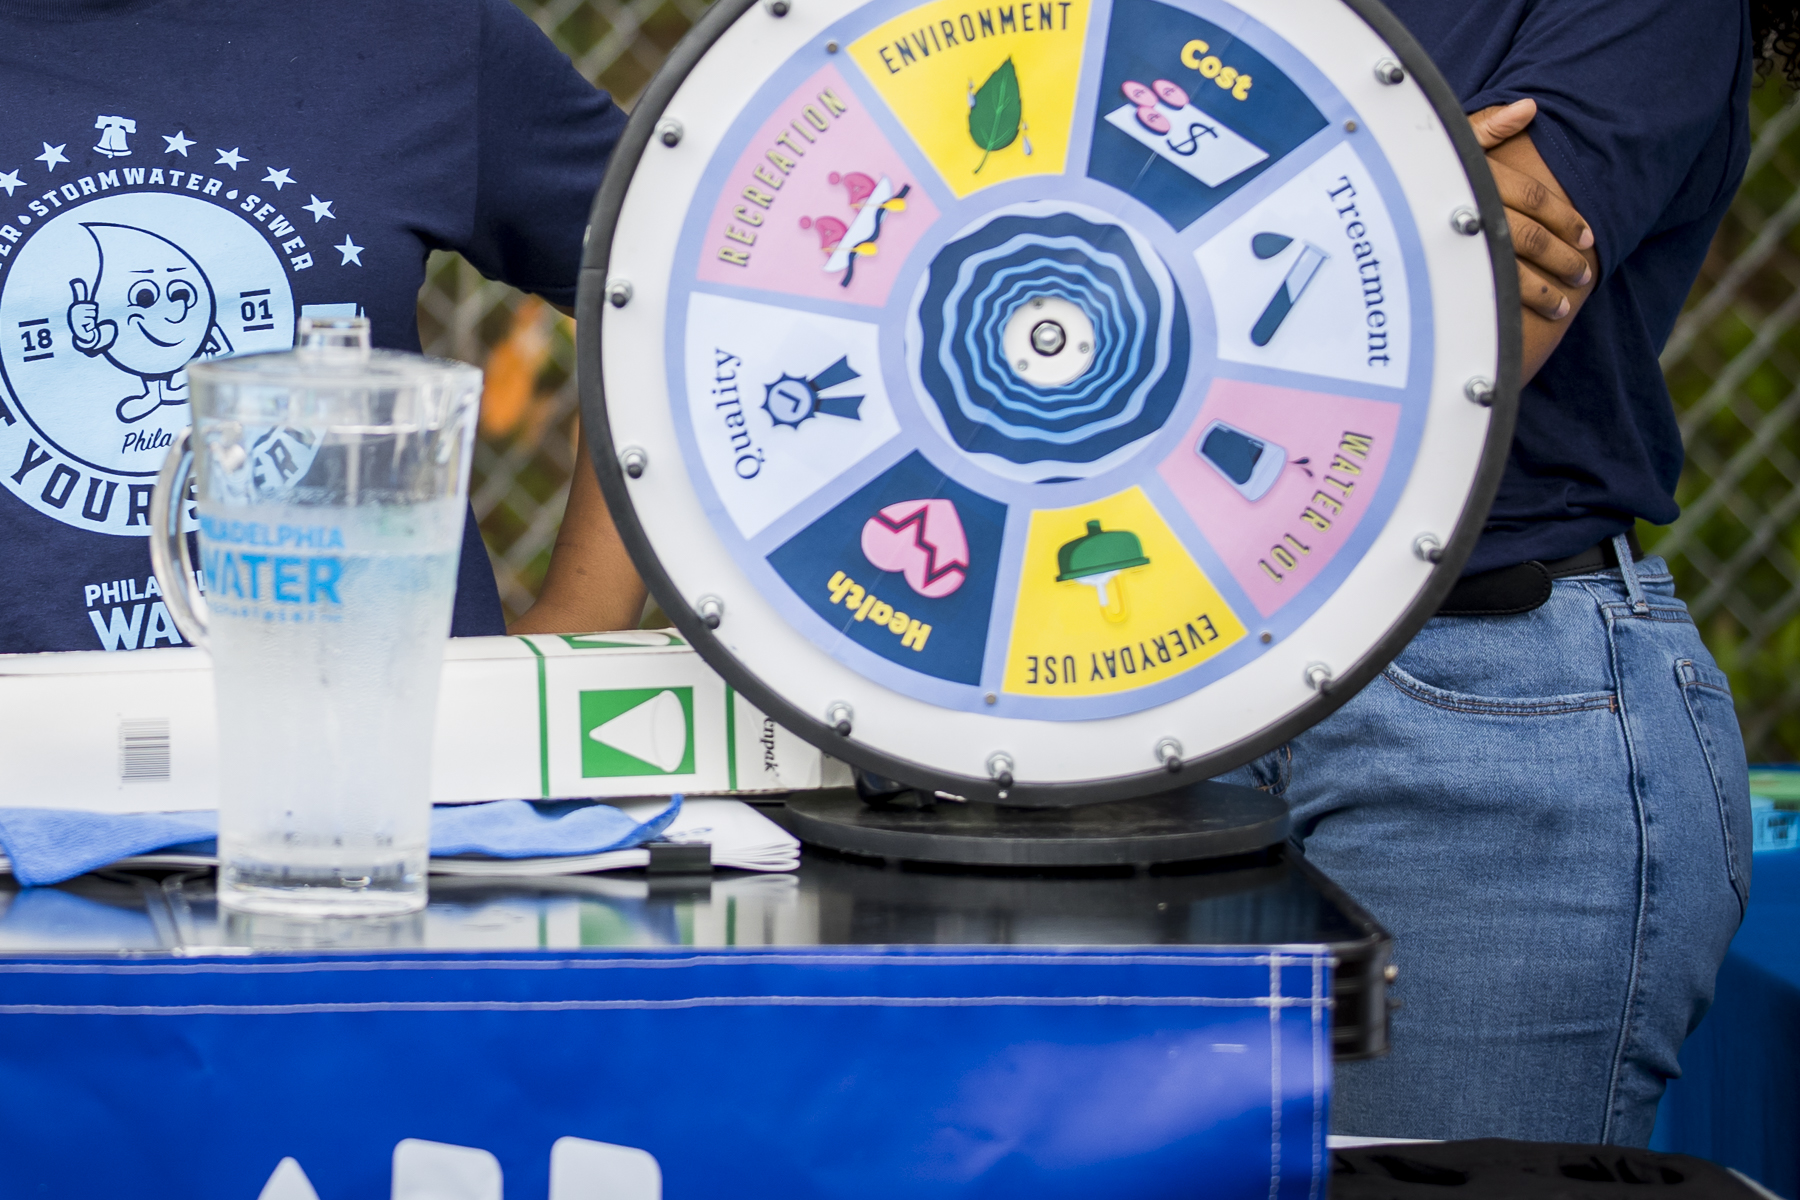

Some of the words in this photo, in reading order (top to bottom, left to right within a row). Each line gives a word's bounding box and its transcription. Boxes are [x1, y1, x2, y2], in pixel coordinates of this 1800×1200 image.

[878, 0, 1073, 75] ENVIRONMENT
[1180, 39, 1253, 101] Cost
[717, 86, 848, 267] RECREATION
[28, 167, 223, 217] STORMWATER
[240, 194, 314, 272] SEWER
[1325, 174, 1390, 367] Treatment
[20, 327, 54, 352] 18
[240, 299, 273, 322] 01
[711, 347, 766, 481] Quality
[11, 438, 154, 526] YOUR
[1299, 430, 1374, 532] WATER
[1258, 532, 1312, 584] 101
[826, 570, 932, 652] Health
[1089, 612, 1220, 683] EVERYDAY
[1025, 654, 1077, 685] USE
[759, 716, 780, 773] enpak
